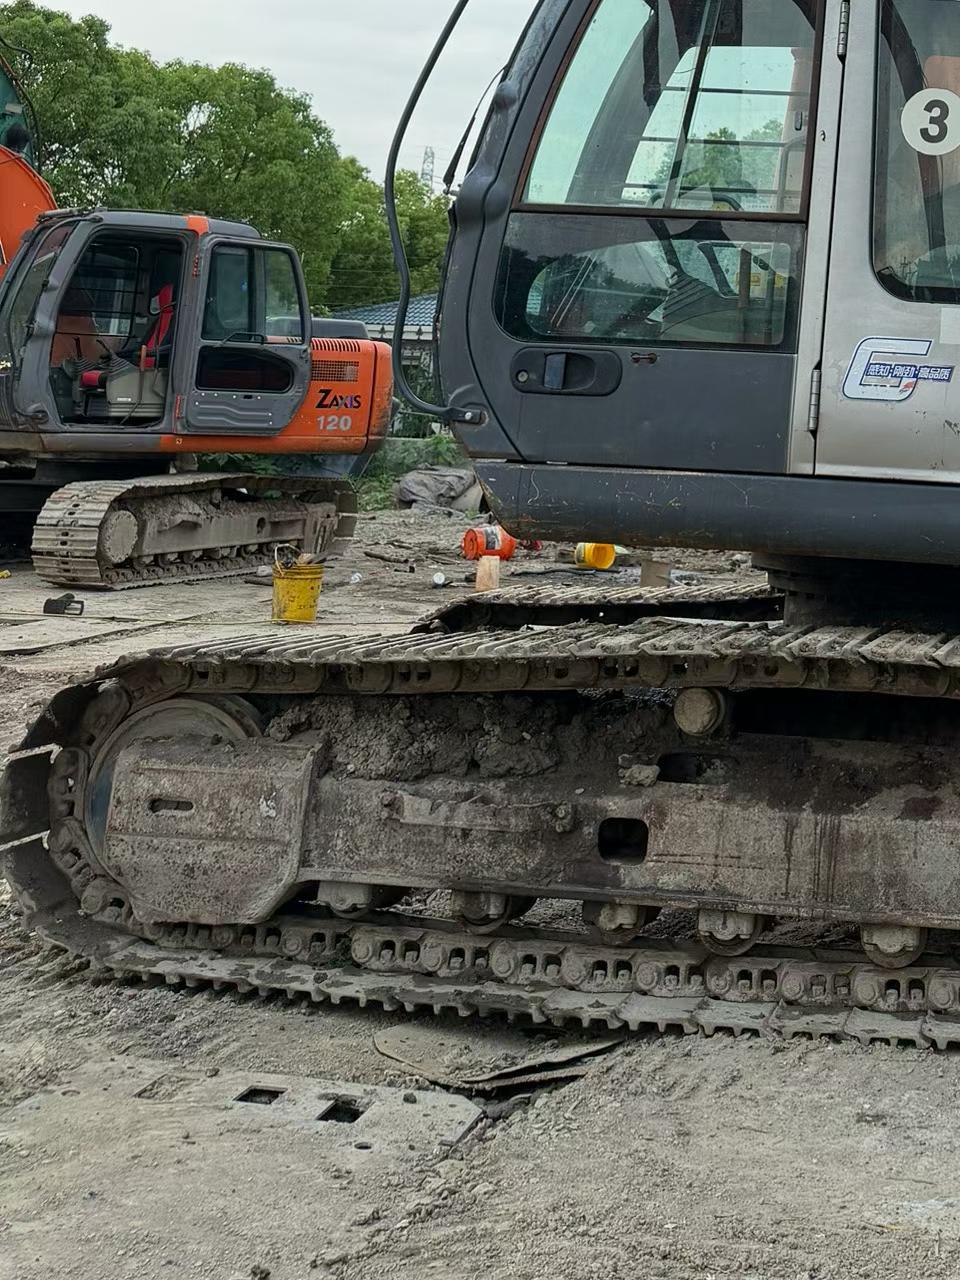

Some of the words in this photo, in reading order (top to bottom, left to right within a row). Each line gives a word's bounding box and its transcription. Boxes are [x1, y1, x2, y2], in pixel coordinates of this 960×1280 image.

[920, 99, 950, 144] 3
[316, 388, 362, 409] ZAXIS
[317, 415, 352, 431] 120
